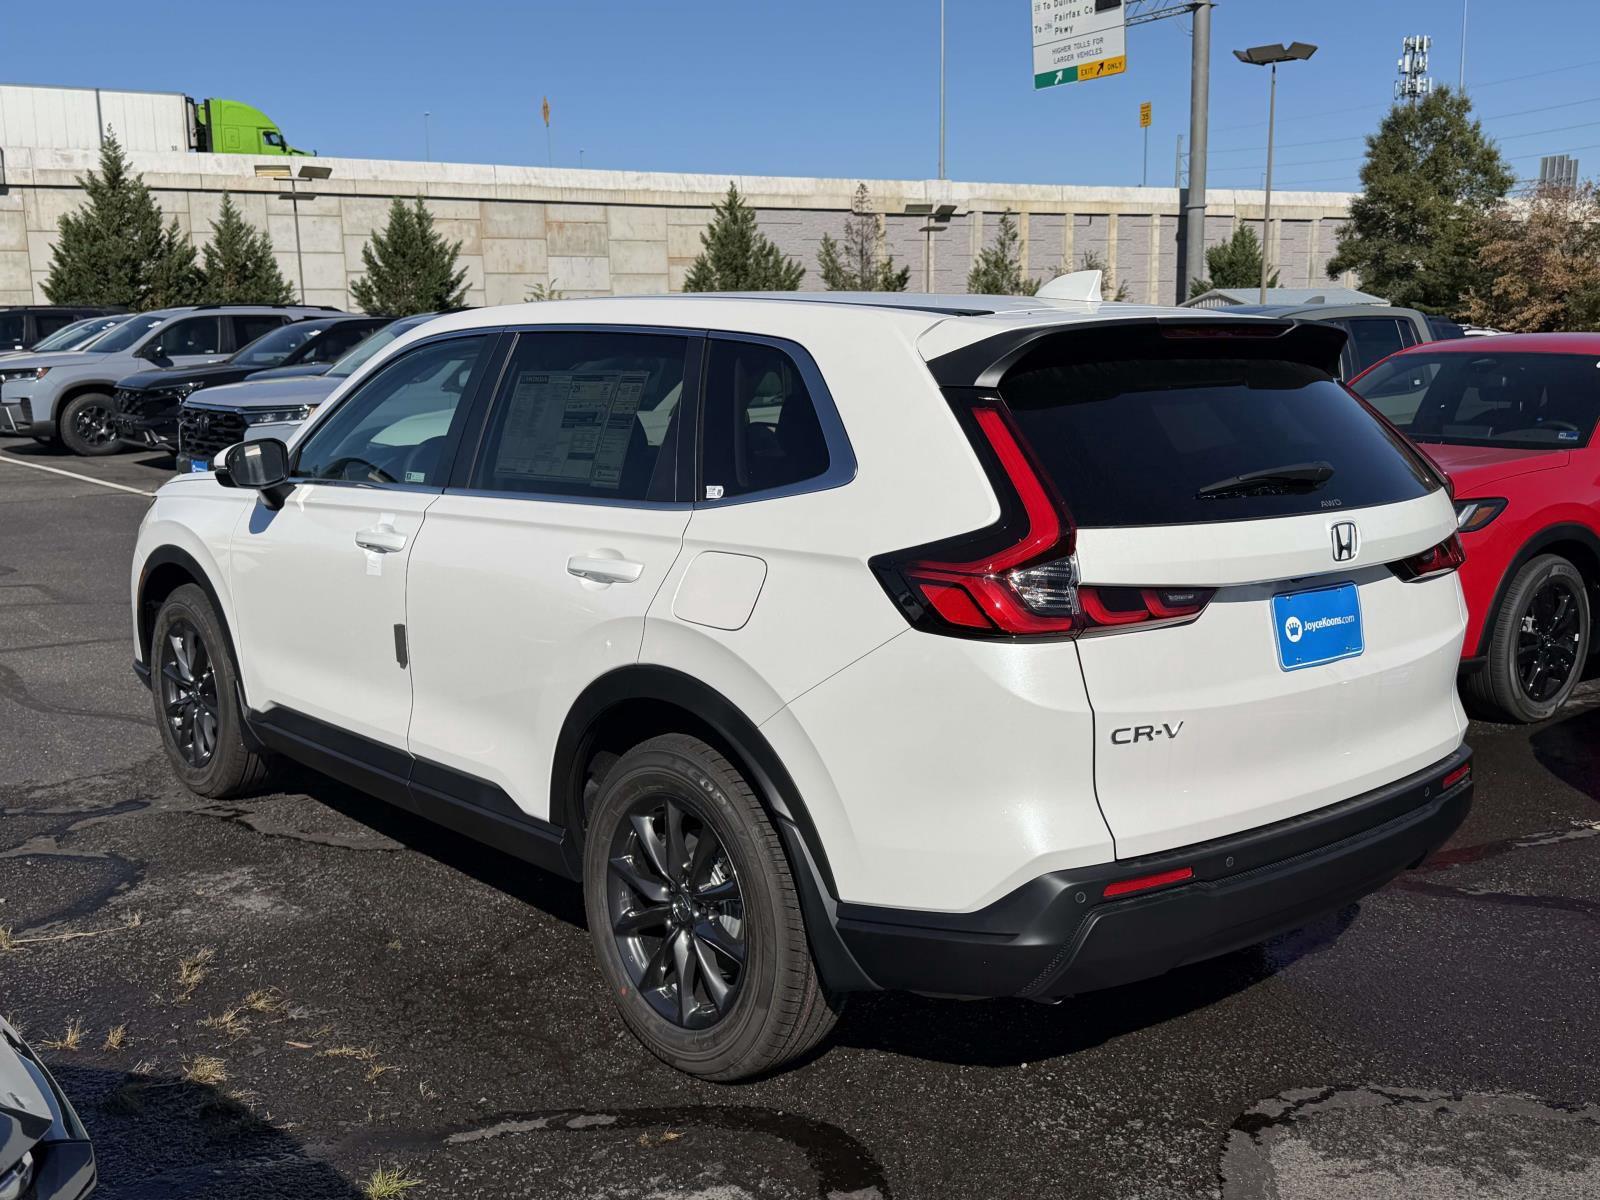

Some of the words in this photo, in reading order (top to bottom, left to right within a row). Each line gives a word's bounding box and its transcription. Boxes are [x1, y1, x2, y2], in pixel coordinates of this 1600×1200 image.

[1043, 2, 1051, 10] To
[1054, 10, 1080, 22] Fairfax
[1084, 6, 1093, 14] Co
[1034, 25, 1042, 34] To
[1054, 25, 1074, 35] Pkwy
[1052, 45, 1071, 55] HIGHER
[1074, 40, 1090, 49] TOLLS
[1092, 37, 1104, 46] FOR
[1053, 54, 1074, 64] LARGER
[1077, 47, 1103, 59] VEHICLES
[1080, 67, 1093, 76] EXIT
[1107, 62, 1123, 71] ONLY
[1320, 499, 1342, 507] AWD
[1304, 615, 1355, 632] JoyceKoons.com
[1111, 721, 1184, 744] CR-V
